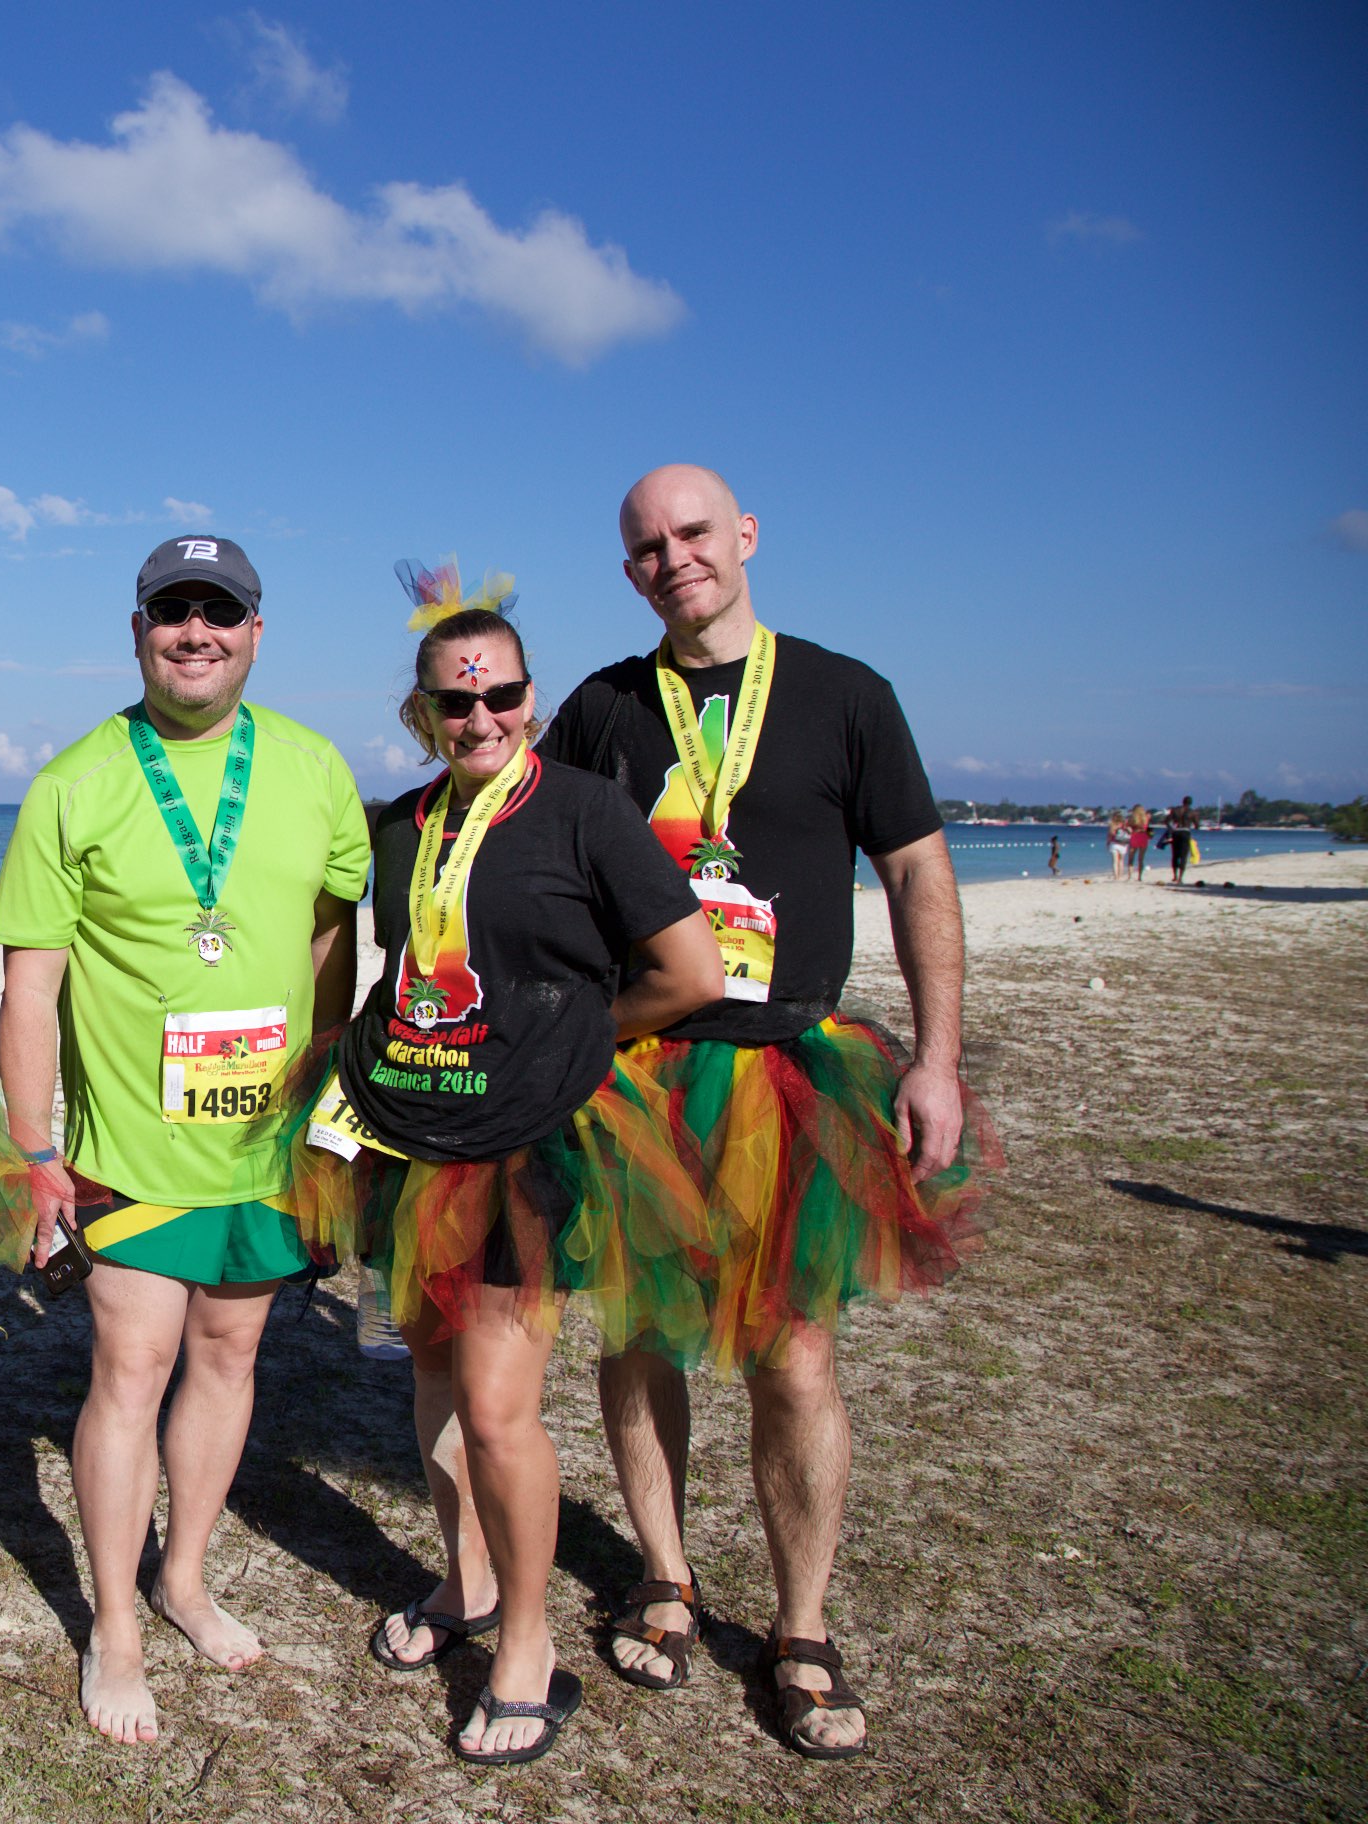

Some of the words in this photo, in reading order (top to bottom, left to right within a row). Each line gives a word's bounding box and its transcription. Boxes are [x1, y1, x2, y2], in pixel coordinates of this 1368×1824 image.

[726, 761, 741, 797] Reggae
[735, 737, 747, 757] Half
[742, 688, 760, 733] Marathon
[753, 664, 763, 685] 2016
[758, 632, 767, 662] Finisher
[671, 686, 687, 730] Marathon
[683, 732, 694, 758] 2016
[692, 760, 711, 799] Finisher
[146, 753, 167, 785] 2016
[234, 750, 246, 773] 10K
[160, 789, 178, 813] 10K
[228, 777, 242, 810] 2016
[176, 818, 200, 865] Reggae
[218, 814, 236, 866] Finisher
[444, 872, 457, 894] Half
[454, 825, 479, 869] Marathon
[475, 802, 492, 822] 2016
[489, 768, 517, 800] Finisher
[418, 866, 427, 890] 2016
[416, 894, 424, 934] Finisher
[733, 916, 767, 932] PUMA
[167, 1034, 206, 1054] HALF
[256, 1036, 280, 1051] PUMA
[386, 1040, 470, 1067] Marathon
[368, 1059, 432, 1092] Jamaica
[438, 1070, 488, 1095] 2016
[184, 1082, 272, 1118] 14953
